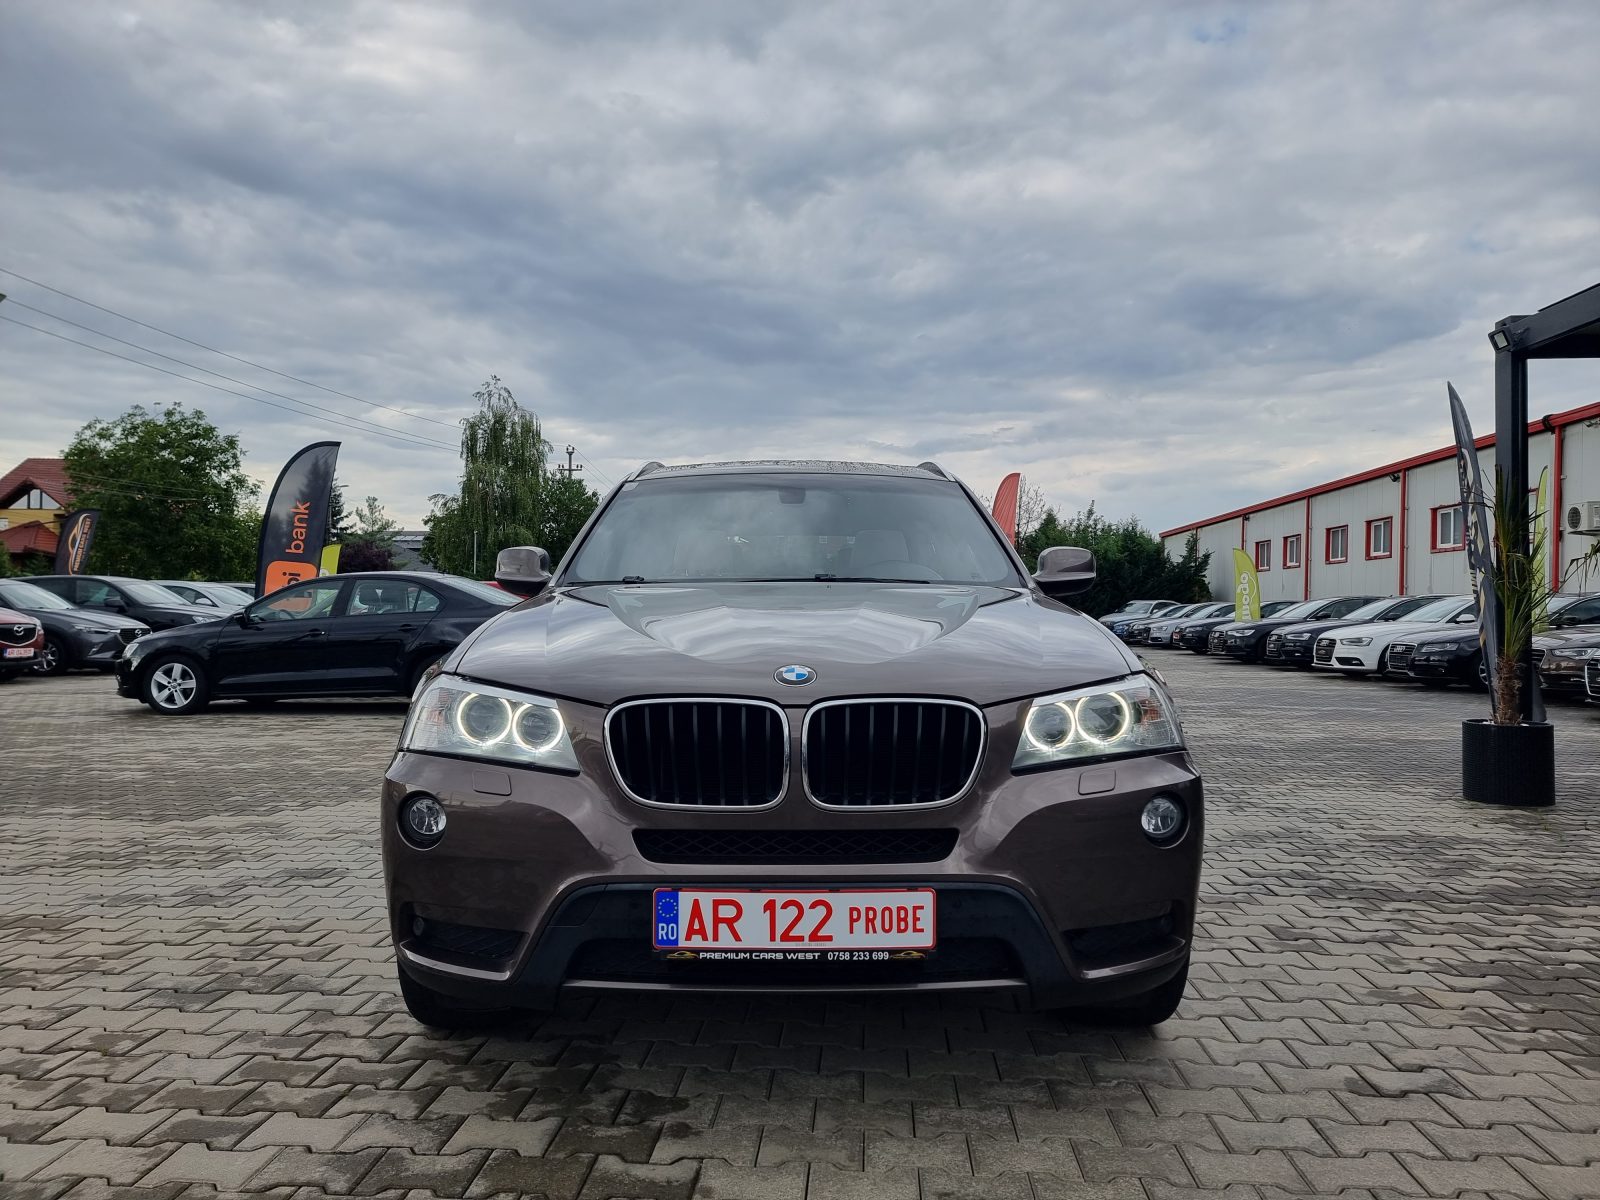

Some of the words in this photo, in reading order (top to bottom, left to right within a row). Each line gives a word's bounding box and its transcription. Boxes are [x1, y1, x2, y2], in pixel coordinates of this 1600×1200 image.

[285, 501, 311, 554] bank
[658, 923, 677, 940] RO
[685, 898, 744, 942] AR
[763, 898, 833, 942] 122
[849, 905, 925, 935] PROBE
[699, 952, 750, 960] PREMIUM
[752, 952, 784, 960] CARS
[786, 952, 821, 960] WEST
[827, 951, 850, 961] 0758
[852, 951, 870, 961] 233
[872, 951, 889, 961] 699
